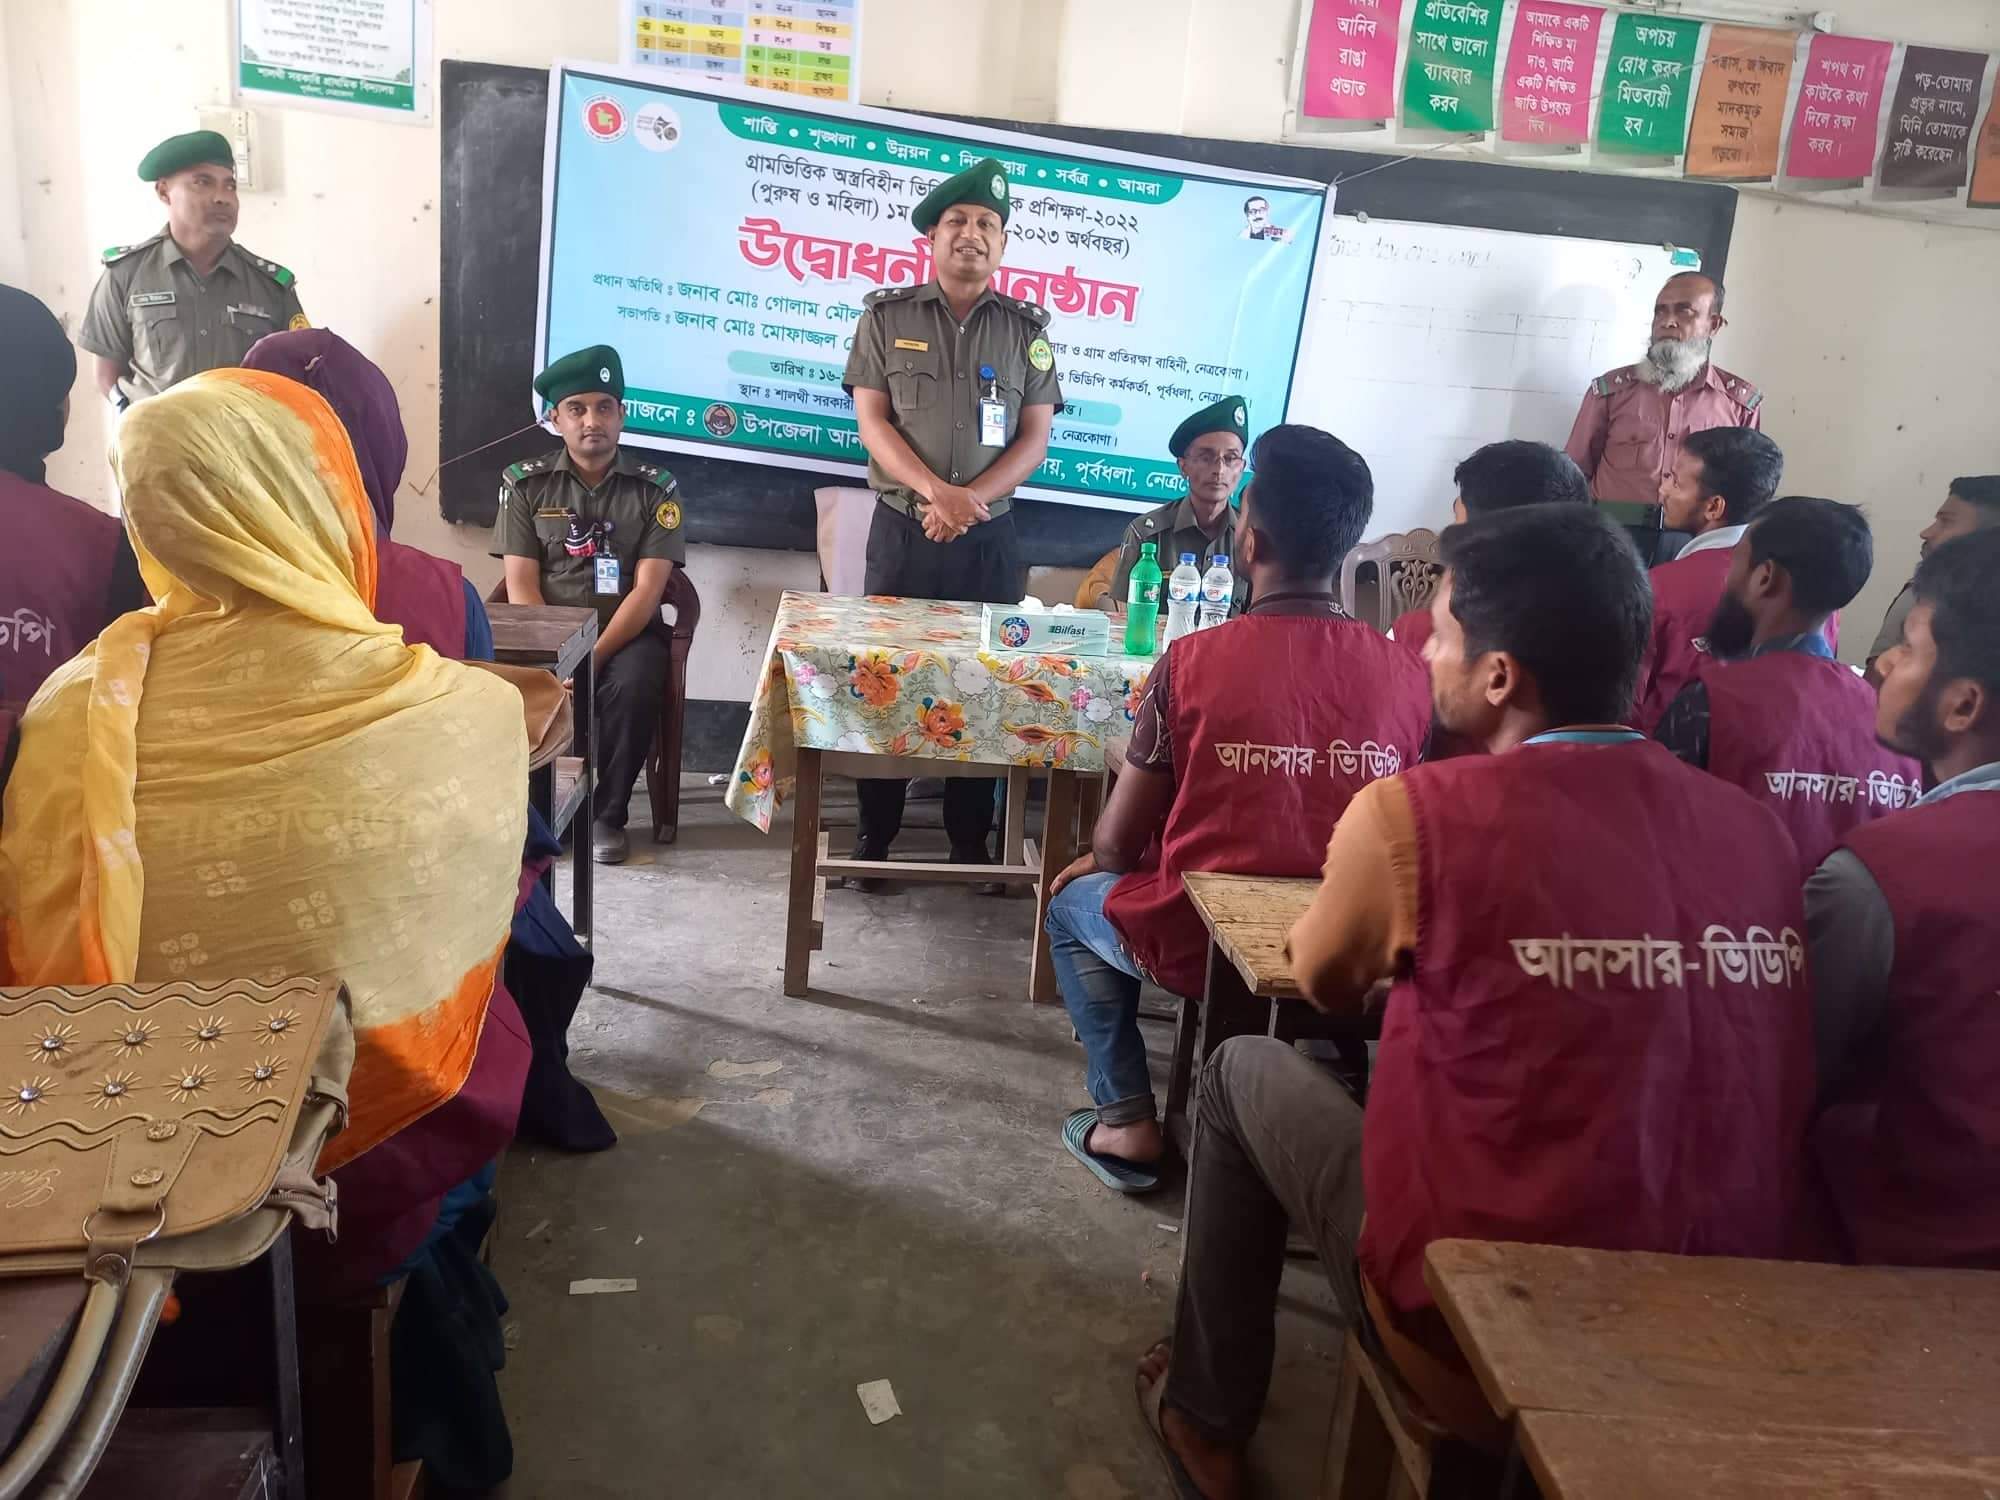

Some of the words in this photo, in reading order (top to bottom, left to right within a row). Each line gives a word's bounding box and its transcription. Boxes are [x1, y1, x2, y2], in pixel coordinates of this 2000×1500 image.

[1425, 0, 1490, 25] প্রতিবেশির
[1526, 11, 1562, 28] আমাকে
[1564, 14, 1590, 31] একটি
[1336, 13, 1377, 39] আনিব
[1635, 26, 1677, 48] অপচয়
[1416, 31, 1448, 52] সাথে
[1451, 36, 1488, 57] ভালো
[1531, 30, 1562, 49] শিক্ষিত
[1566, 38, 1577, 53] মা
[1551, 56, 1575, 72] আমি
[1618, 56, 1648, 76] রোধ
[1651, 59, 1682, 80] করব
[1821, 59, 1849, 78] শপথ
[1329, 76, 1367, 96] প্রভাত
[1517, 74, 1543, 90] একটি
[1545, 75, 1577, 94] শিক্ষিত
[1617, 80, 1672, 110] মিতব্যয়ী
[1805, 82, 1843, 104] কাউকে
[1846, 88, 1869, 108] কথা
[1429, 94, 1460, 114] করব
[1514, 94, 1538, 111] জাতি
[1623, 116, 1643, 136] হব
[1804, 105, 1831, 128] দিলে
[1834, 114, 1856, 133] রক্ষা
[1900, 114, 1922, 135] যিনি
[1925, 121, 1968, 139] তোমাকে
[742, 116, 779, 135] শান্তি
[808, 128, 857, 149] শৃঙ্খলা
[886, 140, 931, 161] উন্নয়ন
[1056, 168, 1090, 187] সর্বত্র
[1117, 178, 1162, 197] আমরা
[1808, 137, 1834, 155] করব
[745, 154, 828, 181] গ্রামভিত্তিক
[832, 168, 906, 196] অস্ত্রবিহীন
[752, 180, 802, 205] (পুরুষ
[807, 192, 820, 206] ও
[826, 190, 880, 221] মহিলা)
[887, 203, 911, 222] ১ম
[1029, 197, 1139, 233] প্রশিক্ষণ-২০২২
[737, 216, 937, 286] উদ্বোধনী
[1065, 229, 1131, 259] অর্থবছর)
[592, 273, 623, 289] প্রধান
[626, 276, 664, 294] অতিথি
[677, 281, 721, 302] জনাব
[726, 290, 759, 309] মোঃ
[765, 295, 820, 317] গোলাম
[825, 301, 864, 323] মৌল
[617, 305, 662, 322] সভাপতি
[674, 310, 719, 331] জনাব
[723, 318, 756, 337] মোঃ
[761, 322, 838, 351] মোফাজ্জল
[770, 360, 805, 377] তারিখ
[1072, 346, 1081, 356] ও
[1083, 347, 1105, 360] গ্রাম
[1107, 348, 1153, 367] প্রতিরক্ষা
[738, 384, 761, 398] স্থান
[1069, 370, 1105, 388] ভিডিপি
[1108, 377, 1151, 395] কর্মকর্তা,
[741, 410, 823, 445] উপজেলা
[1062, 430, 1112, 447] নেত্রকোণা
[1075, 459, 1138, 490] পূর্বধলা,
